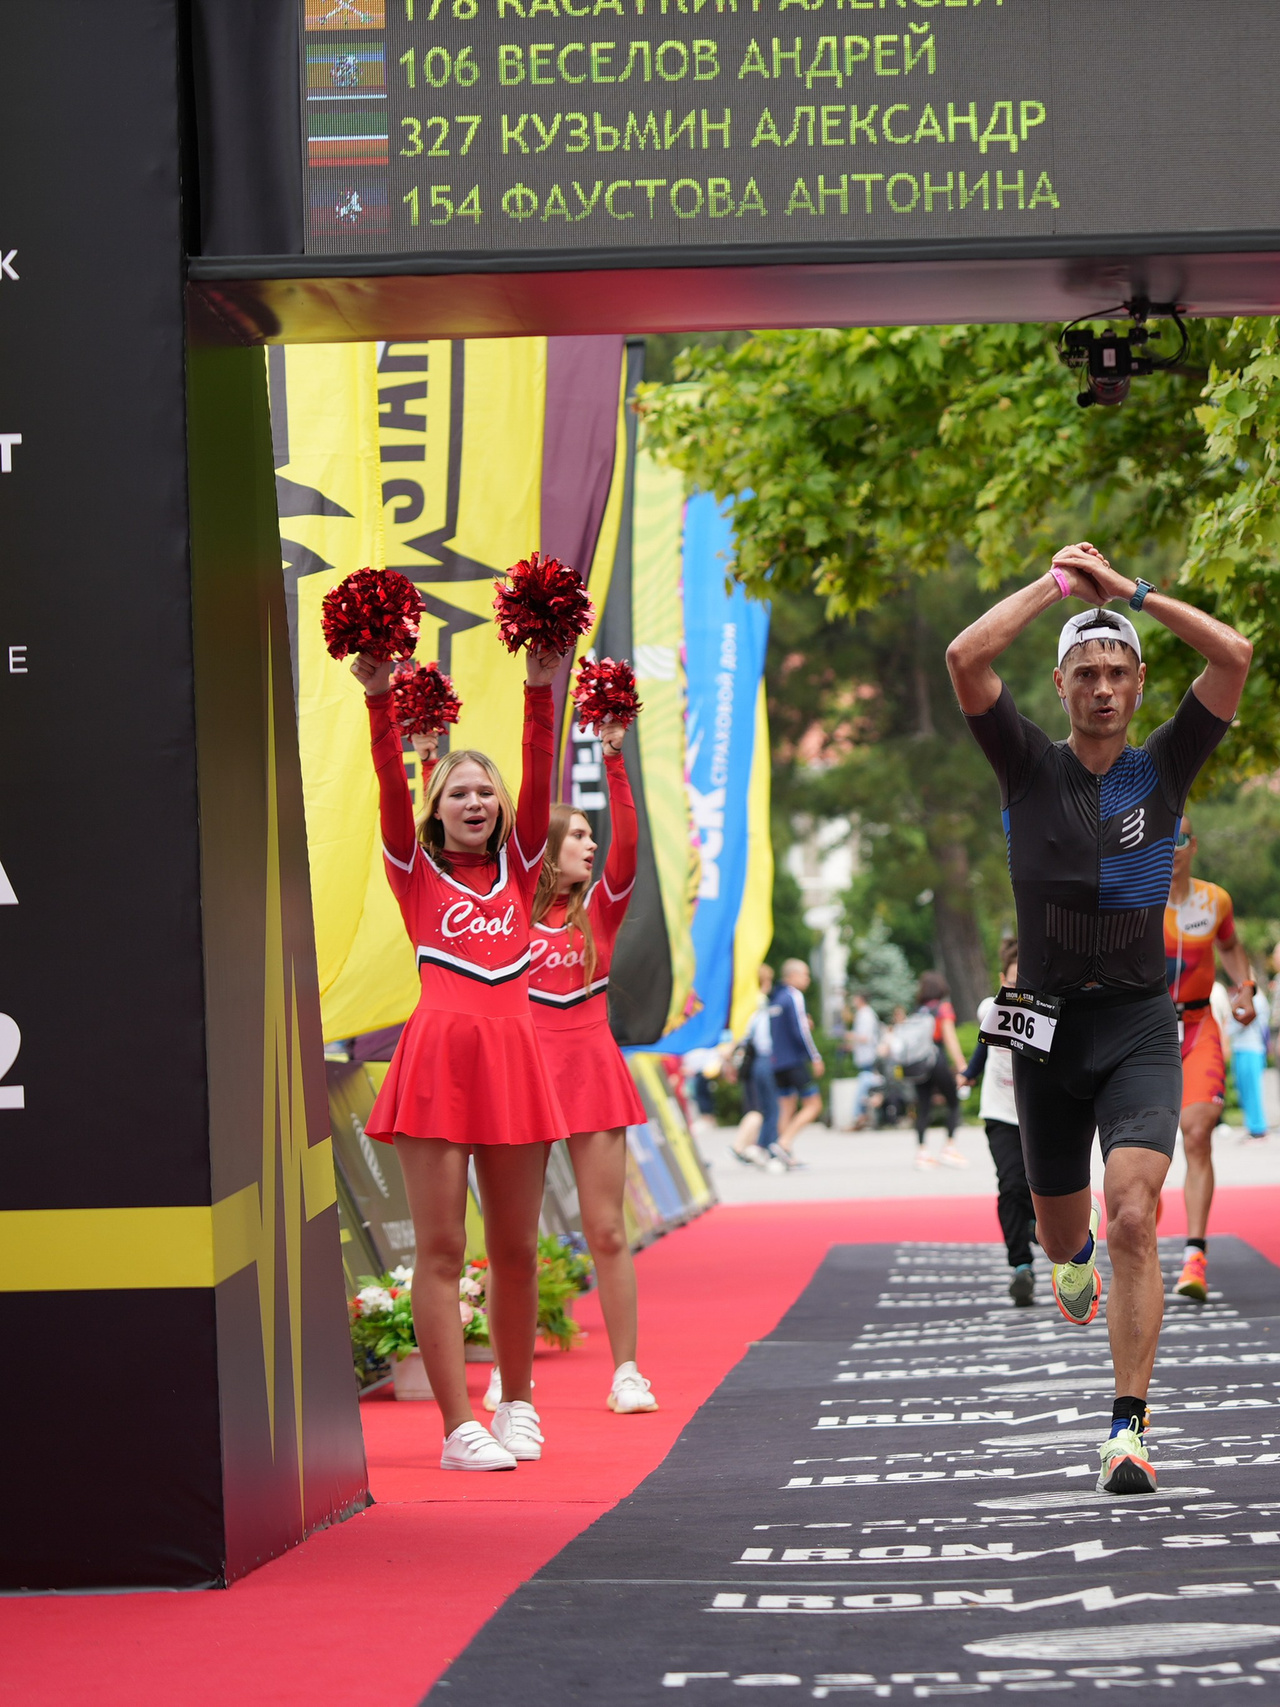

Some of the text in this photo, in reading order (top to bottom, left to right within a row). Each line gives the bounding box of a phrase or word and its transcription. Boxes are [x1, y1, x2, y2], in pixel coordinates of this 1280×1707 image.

[400, 46, 479, 87] 106
[499, 40, 720, 85] ВЕСЕЛОВ
[738, 22, 937, 88] АНДРЕЙ
[400, 115, 482, 156] 327
[501, 109, 731, 154] КУЗЬМИН
[751, 100, 1047, 153] АЛЕКСАНДР
[403, 185, 482, 226] 154
[502, 178, 767, 222] ФАУСТОВА
[786, 170, 1060, 214] АНТОНИНА
[441, 901, 515, 938] Cool
[998, 1011, 1035, 1039] 206
[1010, 1040, 1024, 1050] DENIS
[817, 1411, 1014, 1426] IRON
[786, 1468, 1015, 1487] IRON
[740, 1543, 1014, 1561] IRON
[712, 1589, 1014, 1608] IRON
